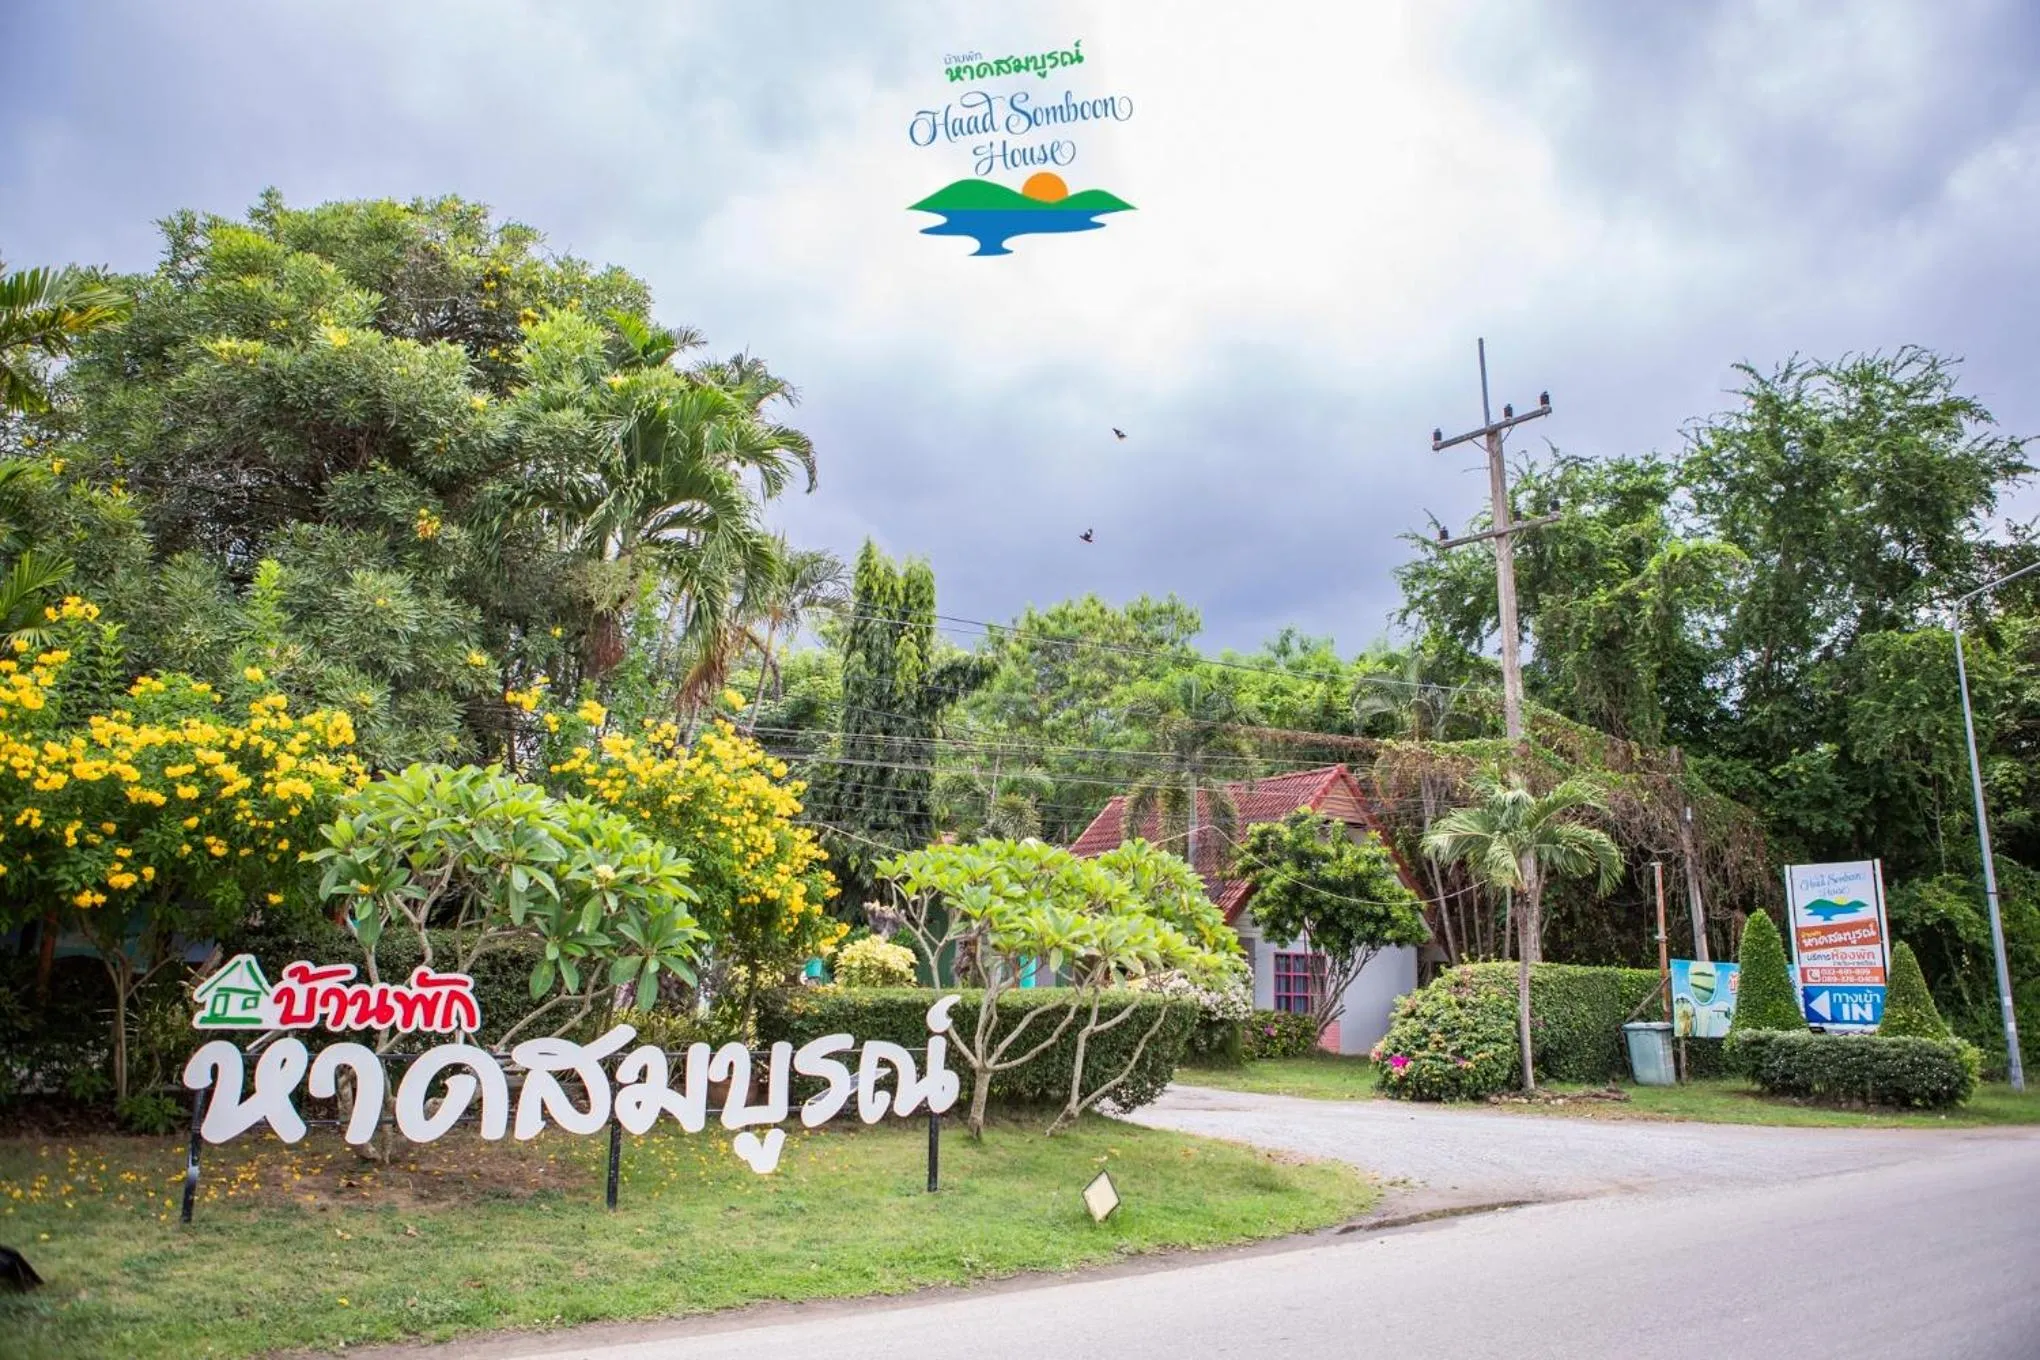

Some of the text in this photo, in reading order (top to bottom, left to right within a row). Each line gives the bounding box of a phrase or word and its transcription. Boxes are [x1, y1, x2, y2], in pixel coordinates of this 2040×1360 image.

[273, 961, 478, 1031] บ้านพัก
[1832, 988, 1881, 1004] ทางเข้า
[1842, 1003, 1874, 1021] IN
[183, 994, 961, 1174] หาดสมบูรณ์
